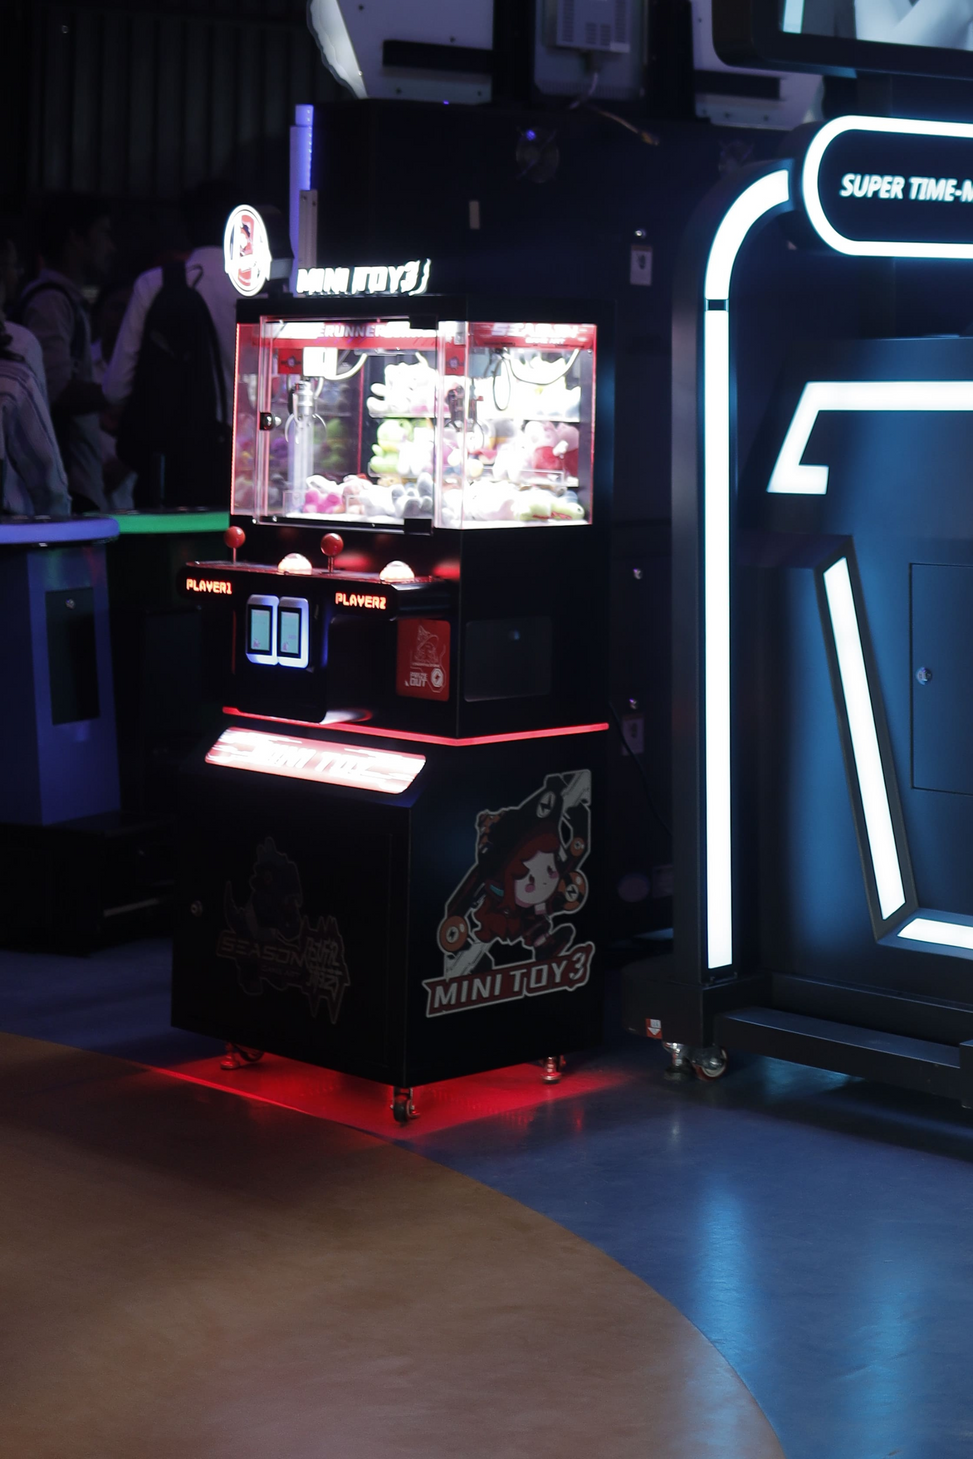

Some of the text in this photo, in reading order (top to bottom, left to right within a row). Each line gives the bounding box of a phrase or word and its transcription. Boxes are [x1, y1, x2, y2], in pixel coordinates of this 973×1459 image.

[839, 173, 905, 200] SUPER
[186, 578, 233, 595] PLAYER1
[335, 592, 387, 610] PLAYER2
[221, 936, 309, 968] SEASON
[433, 973, 503, 1009] MINI
